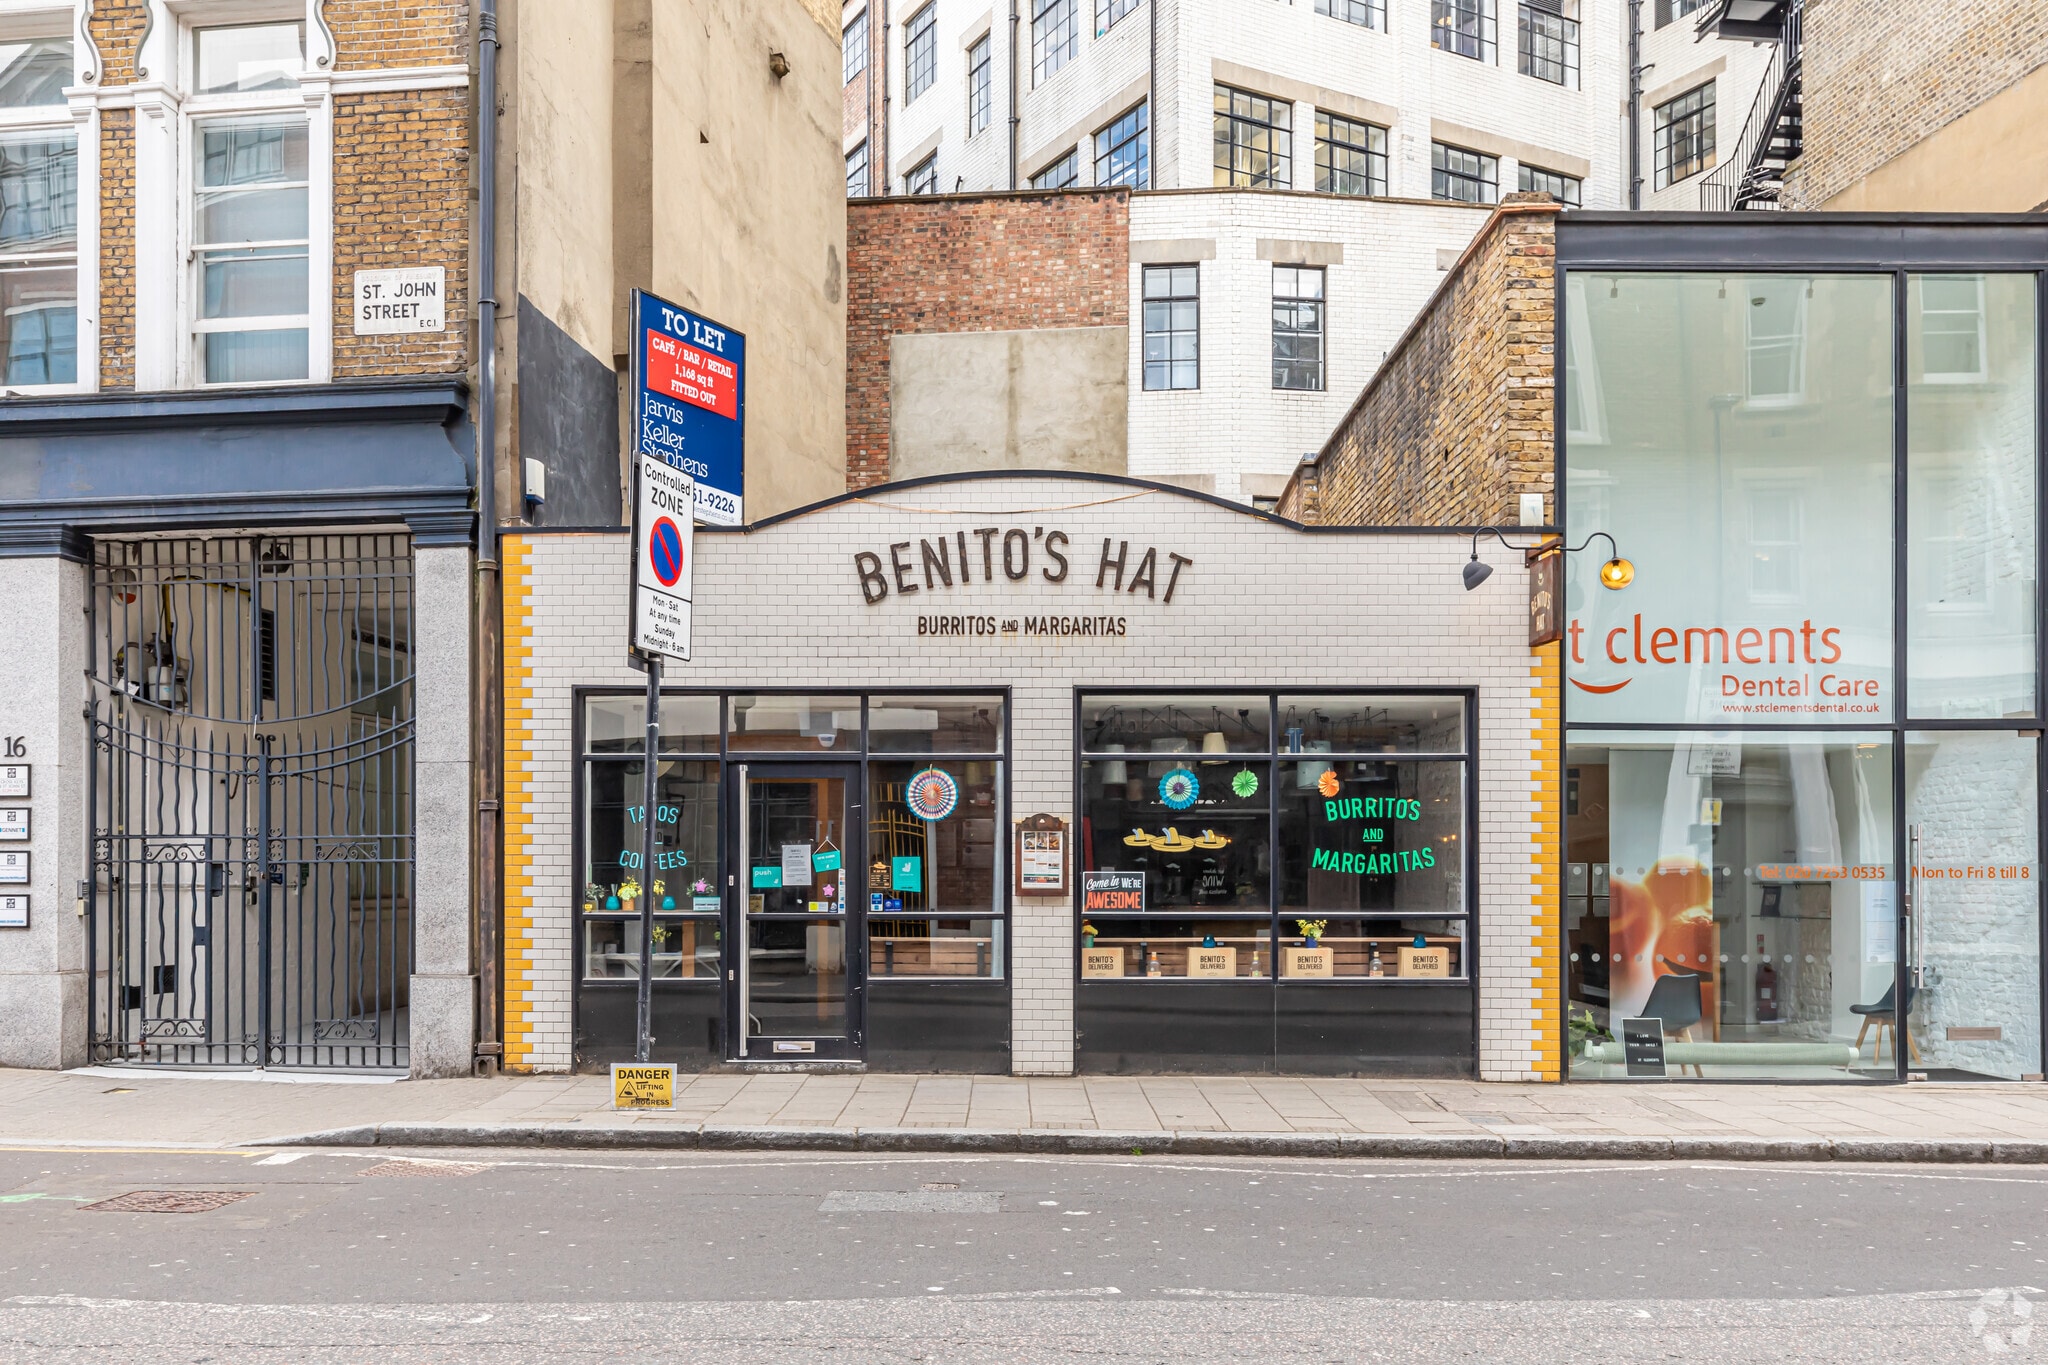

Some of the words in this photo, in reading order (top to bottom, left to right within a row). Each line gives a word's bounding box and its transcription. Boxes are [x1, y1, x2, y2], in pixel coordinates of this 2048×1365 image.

[362, 284, 386, 300] ST.
[394, 281, 436, 298] JOHN
[362, 303, 420, 320] STREET
[661, 307, 689, 337] TO
[693, 320, 726, 353] LET
[652, 337, 676, 356] CAFÉ
[683, 349, 700, 365] BAR
[707, 358, 733, 379] RETAIL
[675, 363, 696, 381] 1,168
[697, 373, 707, 388] sq
[707, 375, 714, 388] ft
[670, 379, 699, 399] FITTED
[700, 390, 717, 406] OUT
[641, 392, 684, 425] Jarvis
[641, 417, 686, 450] Keller
[644, 463, 691, 497] Controlled
[651, 486, 684, 517] ZONE
[854, 526, 1069, 606] BENITO'S
[1095, 537, 1193, 605] HAT
[652, 595, 665, 608] Mon
[668, 600, 679, 612] Sat
[649, 607, 656, 617] At
[657, 612, 668, 623] any
[668, 614, 681, 625] time
[917, 615, 996, 636] BURRITOS
[1001, 618, 1019, 632] AND
[1024, 616, 1127, 636] MARGARITAS
[654, 623, 676, 640] Sunday
[1605, 613, 1842, 664] clements
[643, 633, 669, 650] Midnight
[671, 642, 676, 651] 6
[676, 645, 685, 654] am
[1721, 673, 1809, 697] Dental
[1819, 674, 1879, 697] Care
[1721, 702, 1880, 714] www.stclementsdental.co.uk
[4, 735, 27, 758] 16
[626, 805, 679, 824] TAOS
[1325, 797, 1421, 822] BURRITOS
[1362, 828, 1384, 842] AND
[619, 849, 688, 870] COEES
[1311, 846, 1435, 875] MARGARITAS
[754, 869, 772, 877] push
[1758, 865, 1783, 879] Tel:
[1787, 865, 1811, 879] 020
[1815, 865, 1848, 879] 7253
[1851, 865, 1885, 879] 0535
[1948, 867, 1963, 879] to
[1967, 865, 1984, 878] Fri
[1987, 865, 1996, 879] 8
[2000, 865, 2017, 879] till
[2021, 865, 2030, 879] 8
[1086, 878, 1110, 890] Come
[1110, 875, 1120, 887] in
[1085, 891, 1142, 910] AWESOME
[1088, 955, 1114, 963] BENITO'S
[1200, 955, 1226, 963] BENITO'S
[1297, 955, 1323, 963] BENITO'S
[1412, 955, 1438, 963] BENITO'S
[618, 1069, 670, 1080] DANGER
